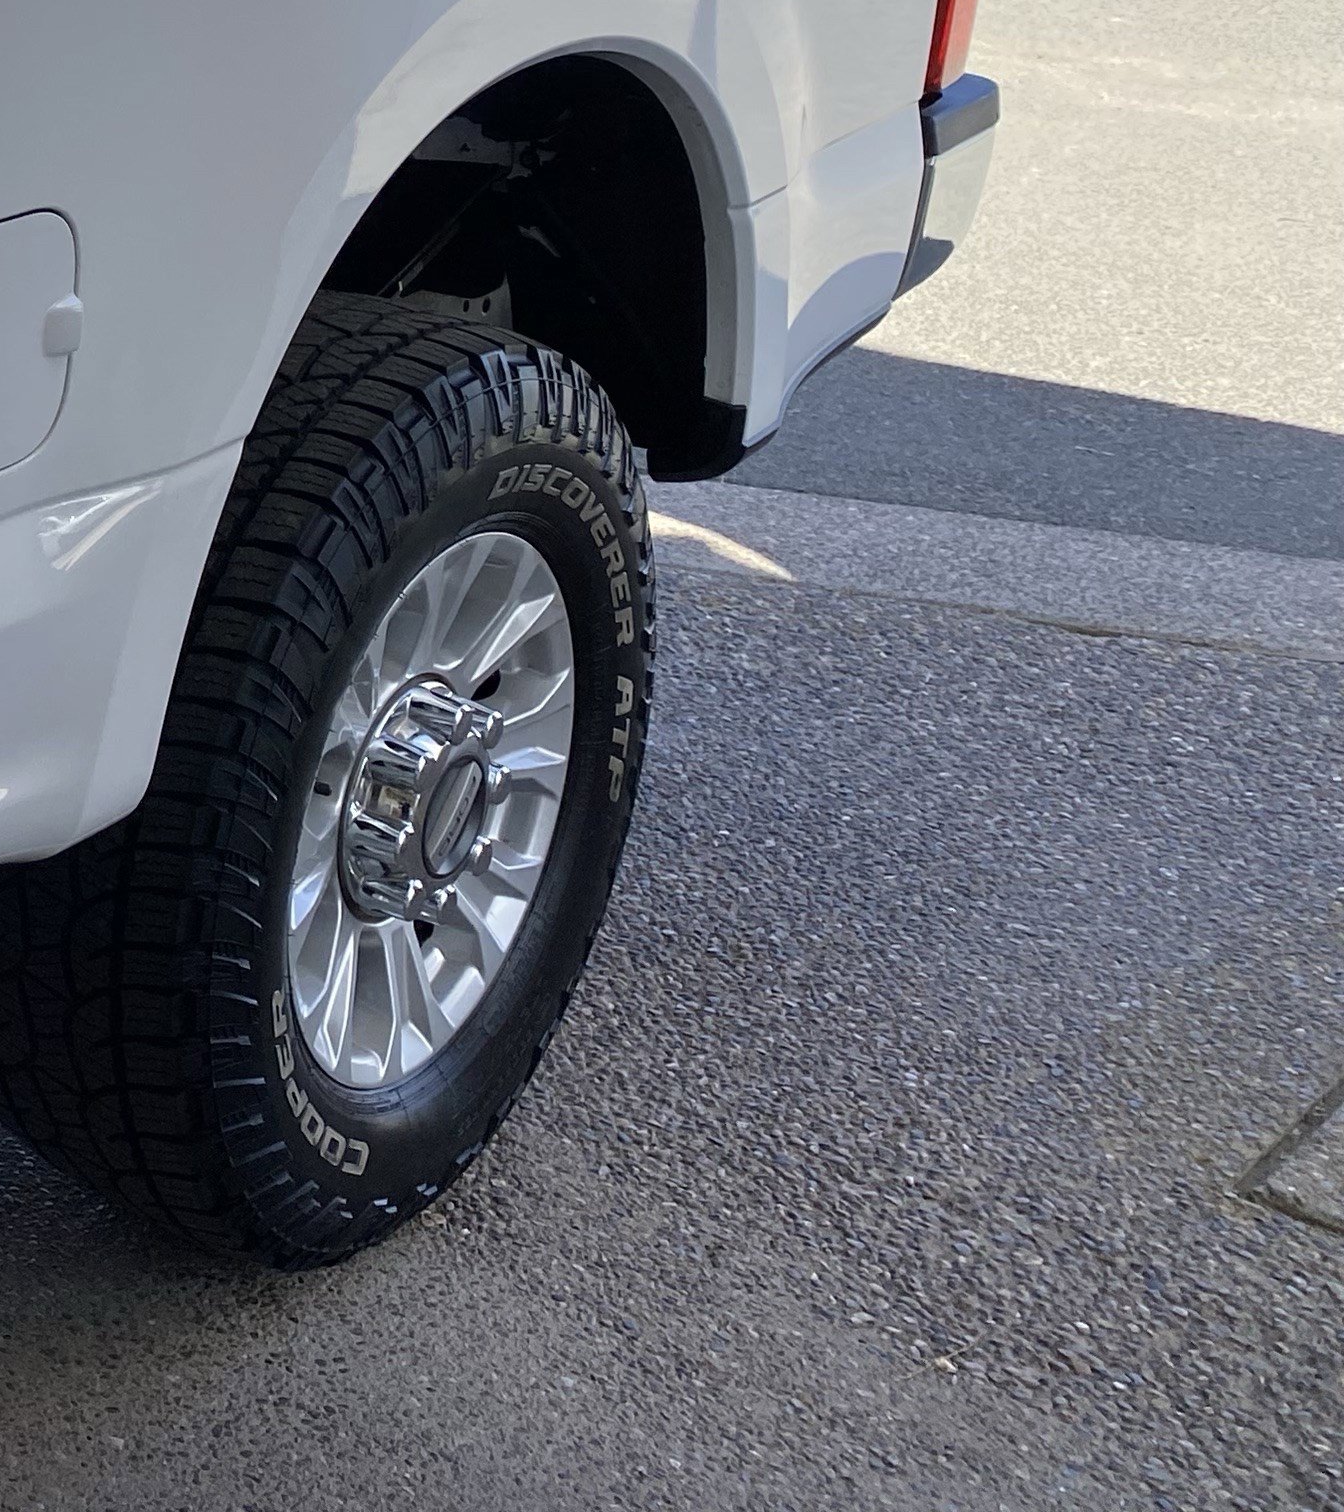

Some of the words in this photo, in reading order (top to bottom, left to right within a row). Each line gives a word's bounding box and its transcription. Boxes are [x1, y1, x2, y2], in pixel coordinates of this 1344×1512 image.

[486, 463, 635, 648] DISCOVERER
[608, 674, 635, 804] ATP
[272, 990, 371, 1176] COOPER
